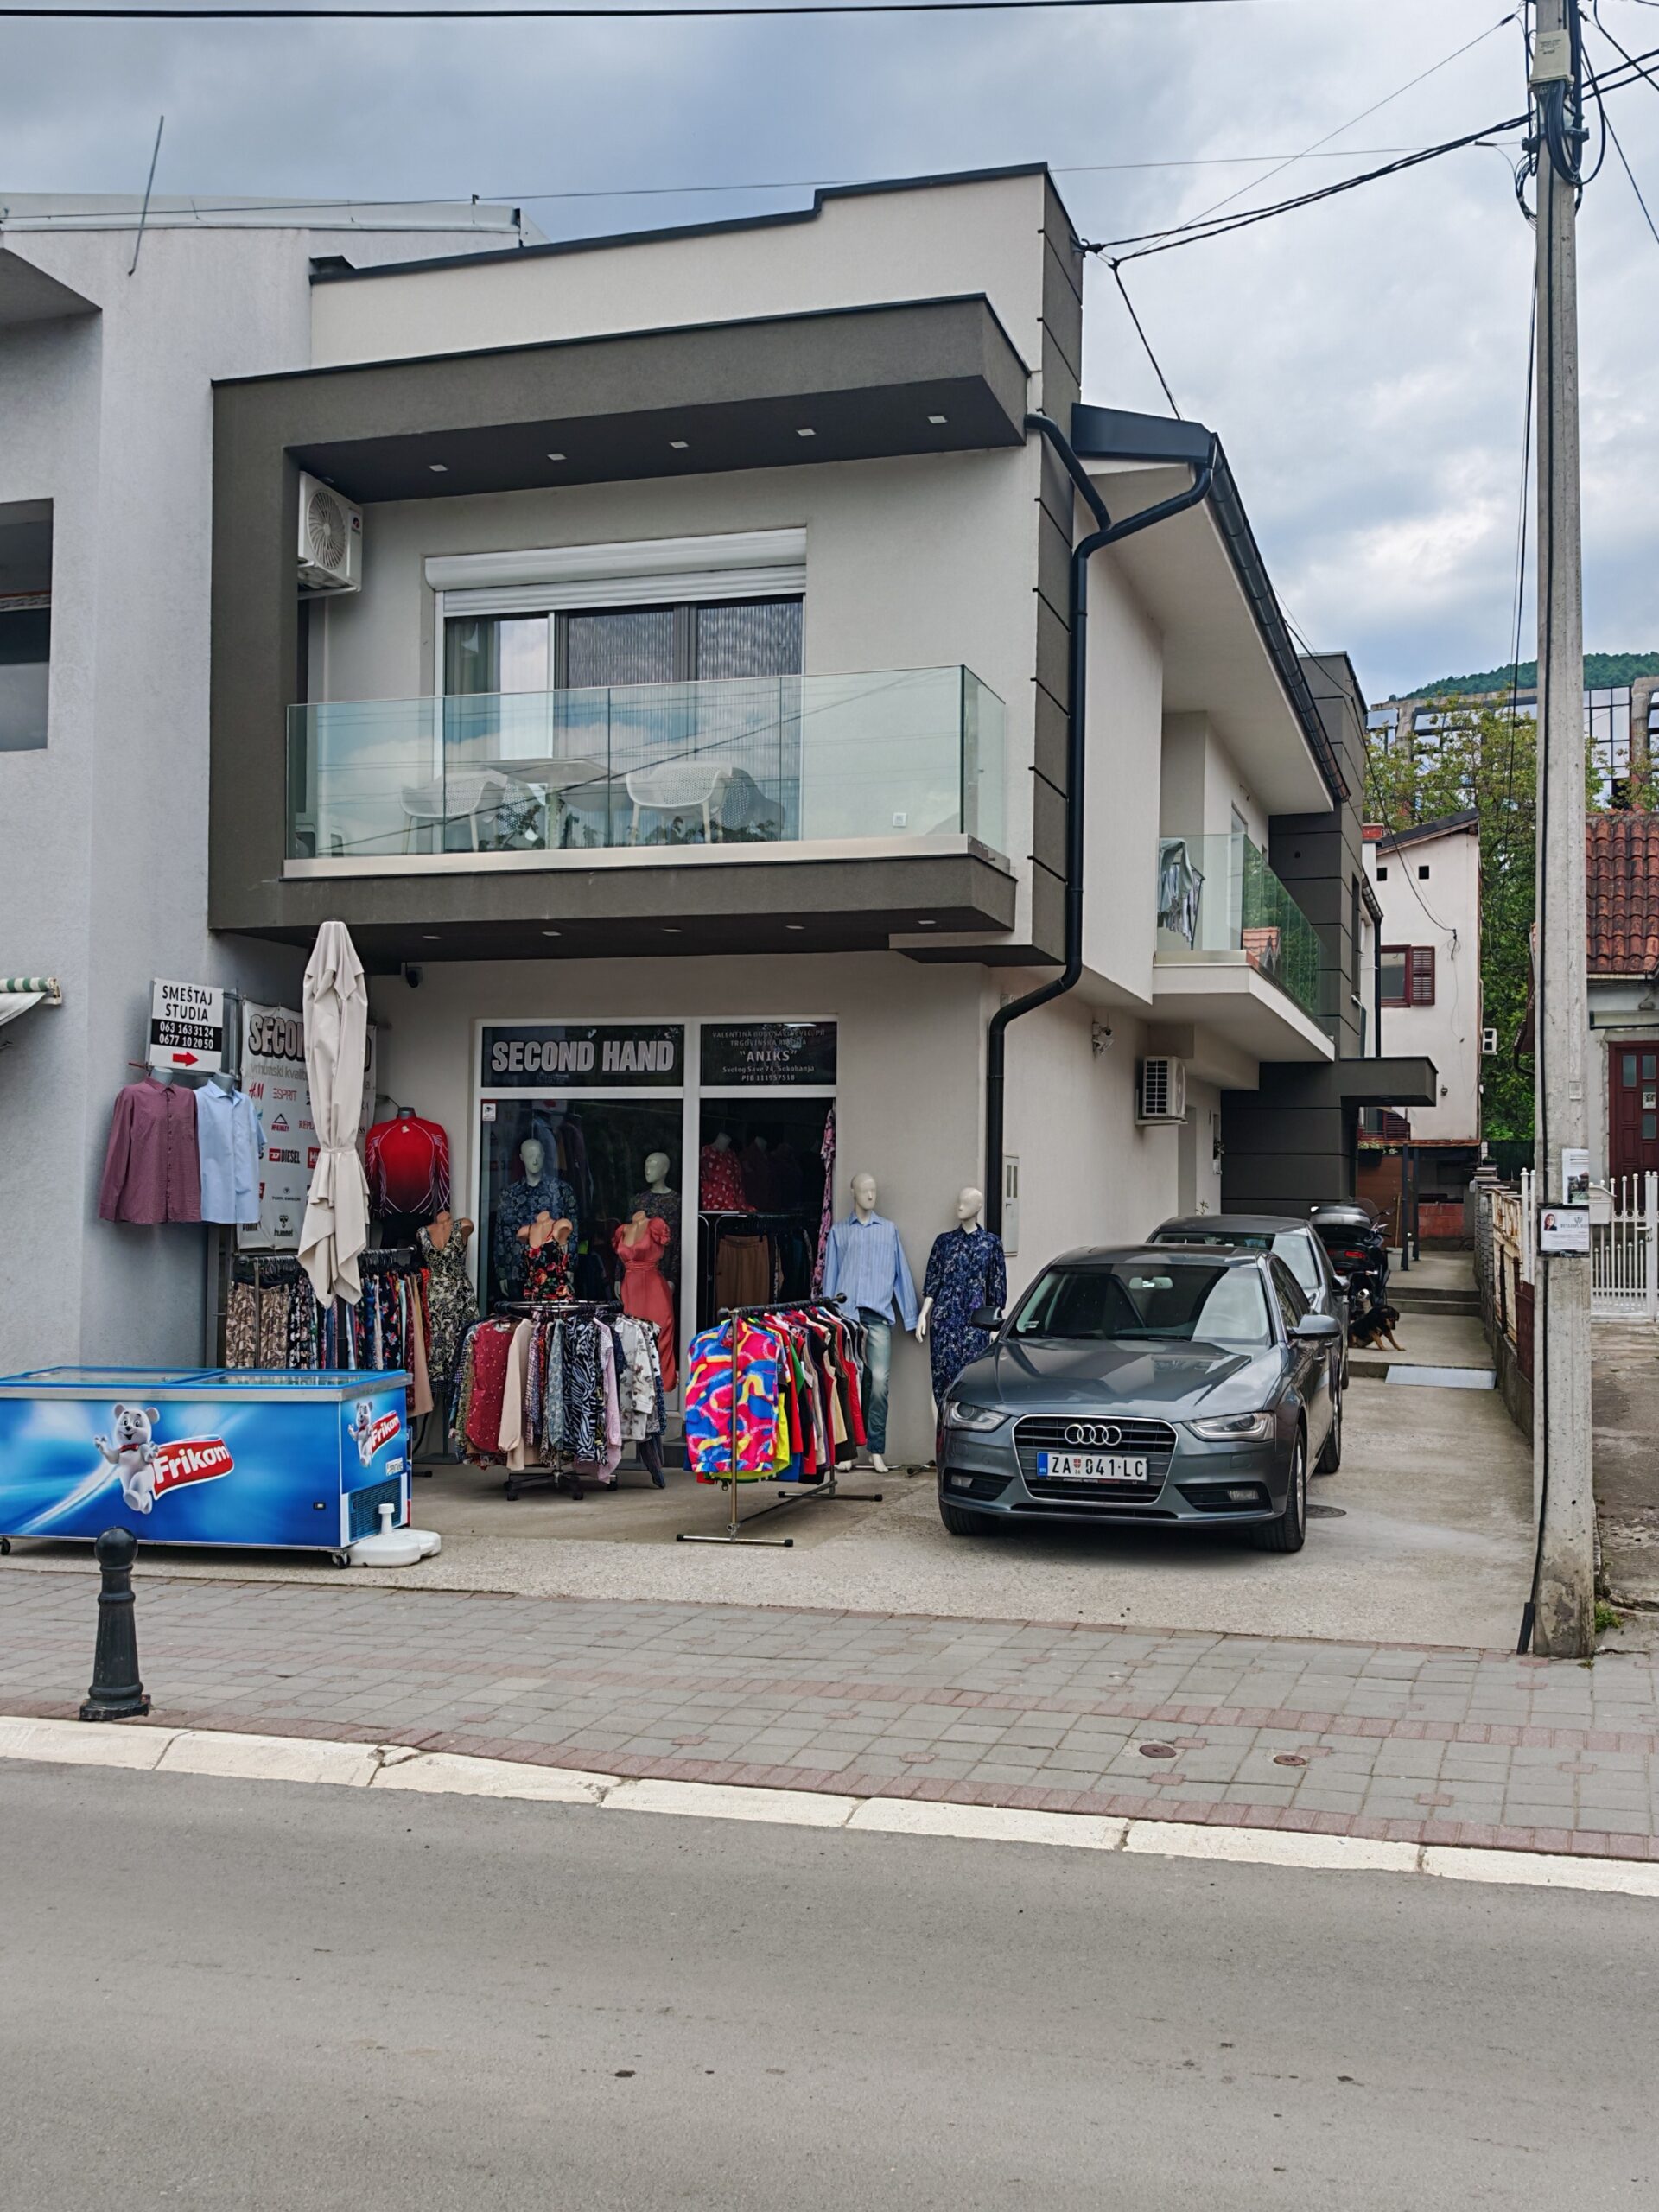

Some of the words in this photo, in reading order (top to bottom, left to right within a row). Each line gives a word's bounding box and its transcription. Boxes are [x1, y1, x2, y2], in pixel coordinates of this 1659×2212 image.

[162, 985, 213, 1006] SMEŠTAJ
[165, 1003, 209, 1022] STUDIA
[159, 1020, 175, 1033] 063
[159, 1033, 180, 1046] 0677
[491, 1041, 595, 1072] SECOND
[601, 1040, 675, 1071] HAND
[298, 1120, 315, 1131] REPL
[282, 1149, 300, 1164] DIESEL
[371, 1415, 400, 1449] Frikom
[153, 1445, 230, 1484] Frikom
[1052, 1457, 1071, 1474] ZA
